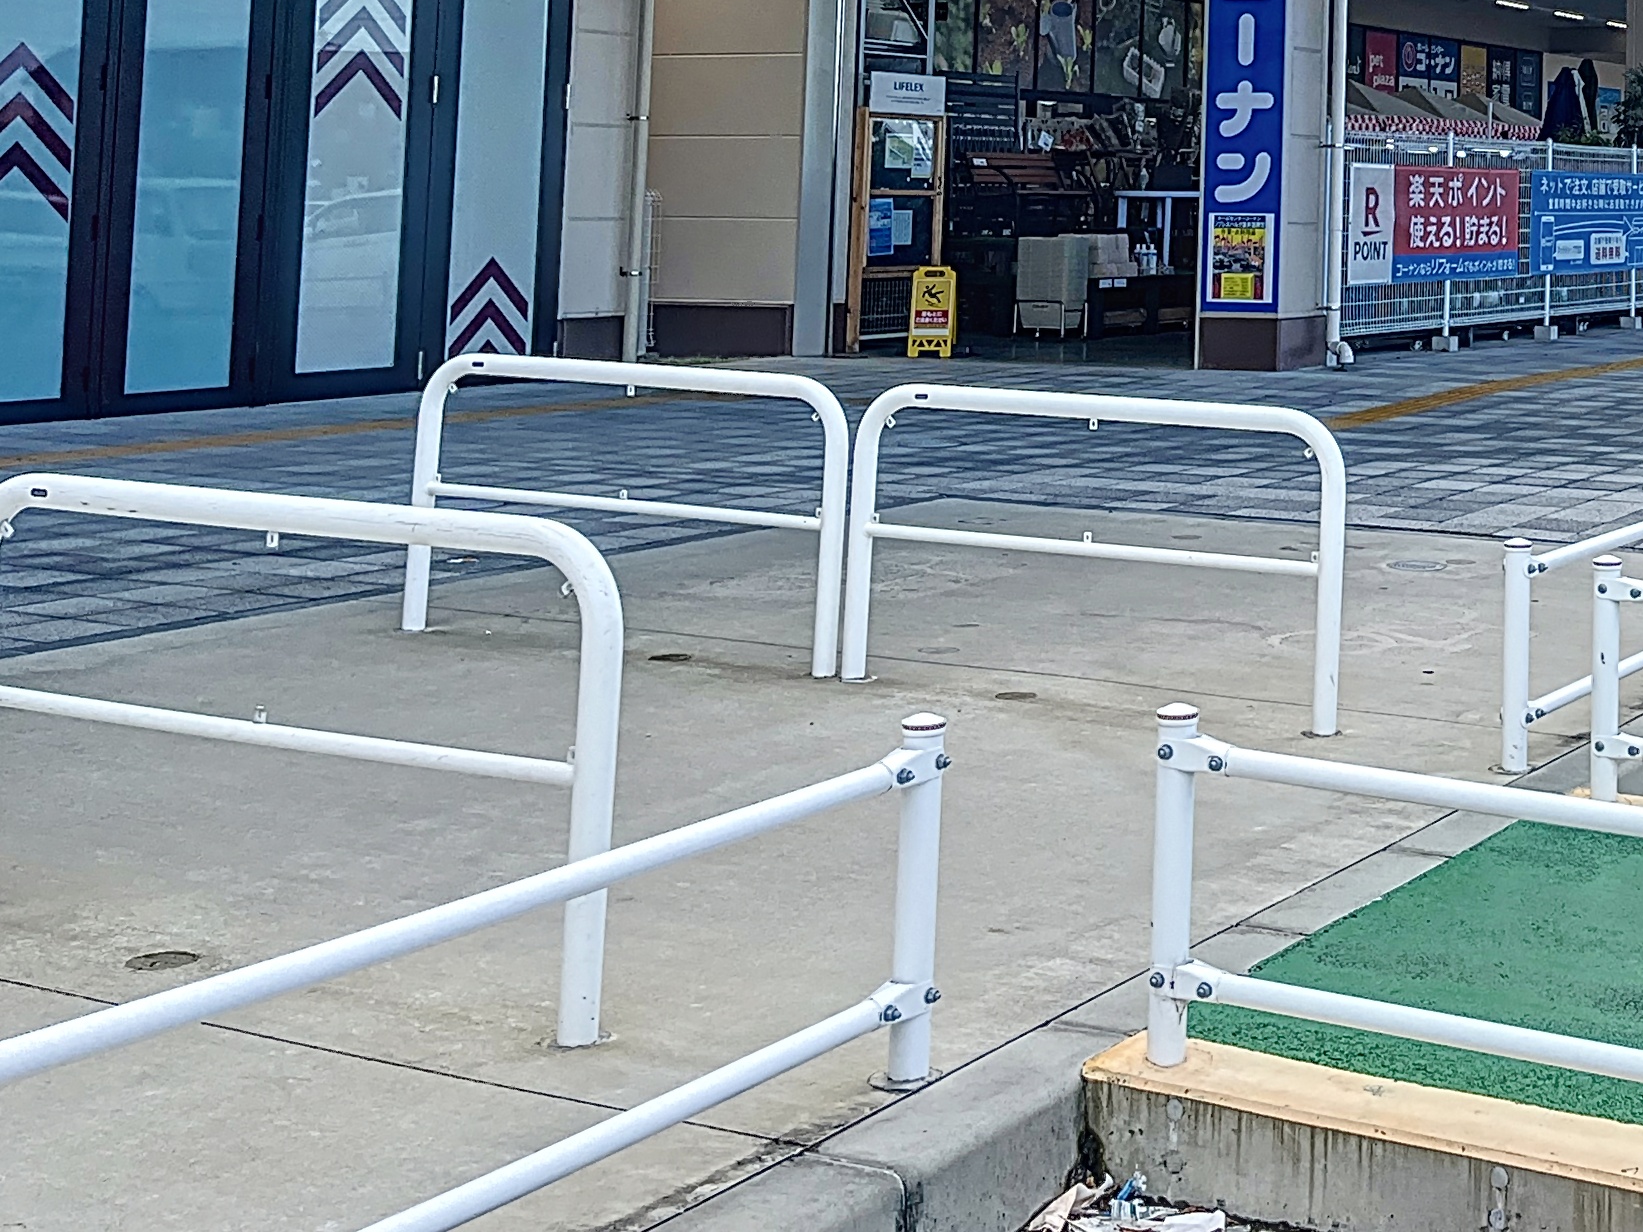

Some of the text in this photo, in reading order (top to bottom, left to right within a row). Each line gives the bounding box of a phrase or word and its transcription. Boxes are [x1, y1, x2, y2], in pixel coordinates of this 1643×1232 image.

[1368, 52, 1384, 72] pet
[893, 81, 925, 92] LIFELEX
[1372, 73, 1395, 88] plaza
[1408, 172, 1507, 208] 楽天ポイント
[1364, 186, 1381, 228] R
[1353, 241, 1389, 261] POINT
